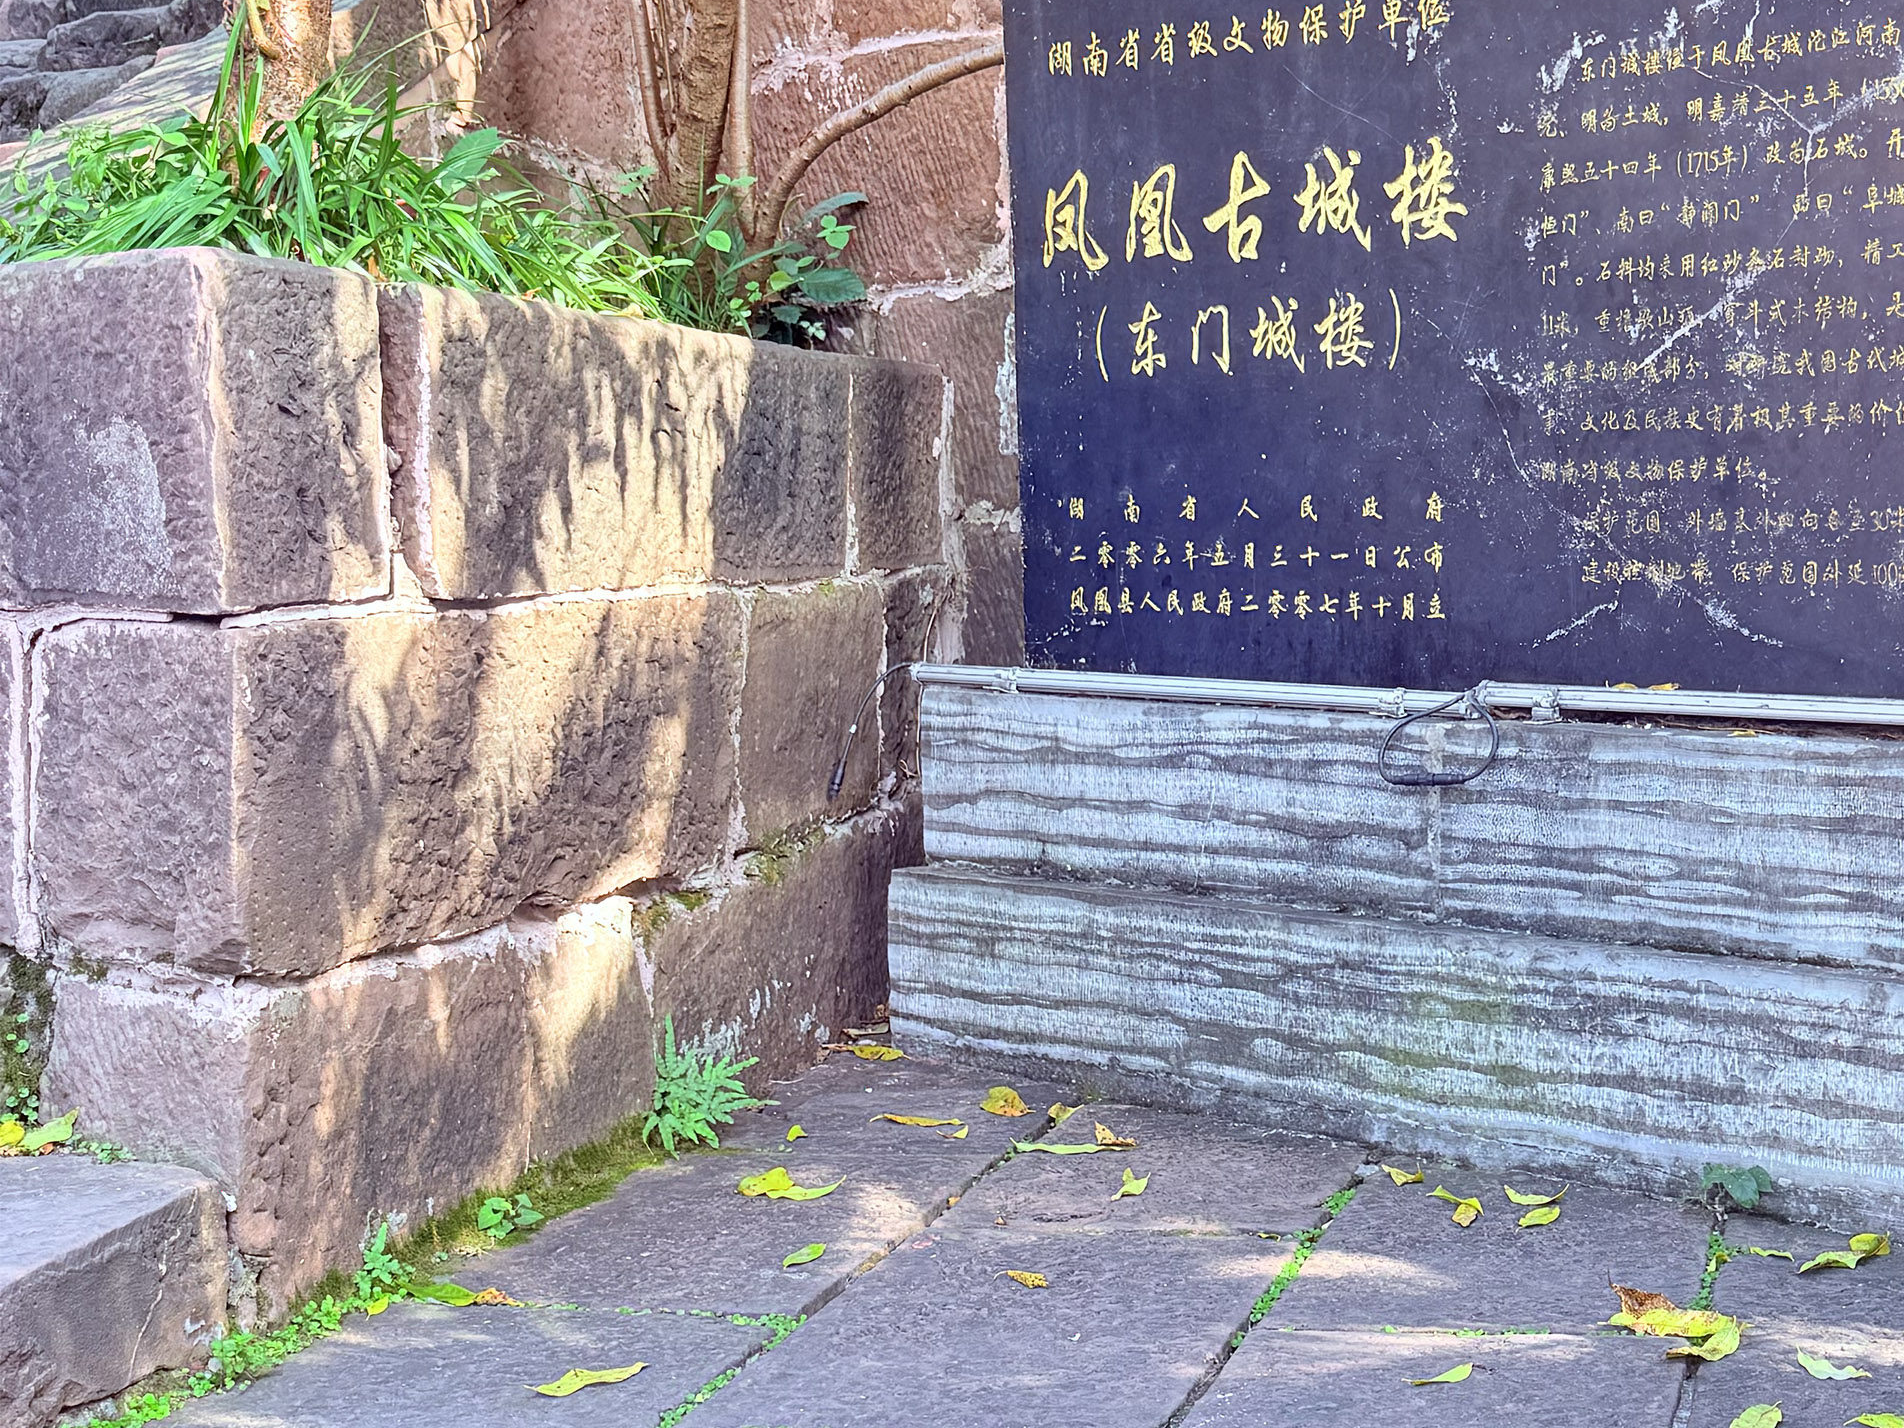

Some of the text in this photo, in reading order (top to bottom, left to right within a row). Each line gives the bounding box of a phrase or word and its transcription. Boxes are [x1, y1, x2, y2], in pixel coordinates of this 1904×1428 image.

[1042, 136, 1469, 270] 凤凰古城楼
[1095, 288, 1403, 383] （东门城楼）
[1069, 490, 1445, 523] 湖南省人民政府
[1069, 540, 1444, 574] 二零零六年五月三十一日公布
[1069, 584, 1446, 622] 凤凰县人民政府二零零七年十月立
